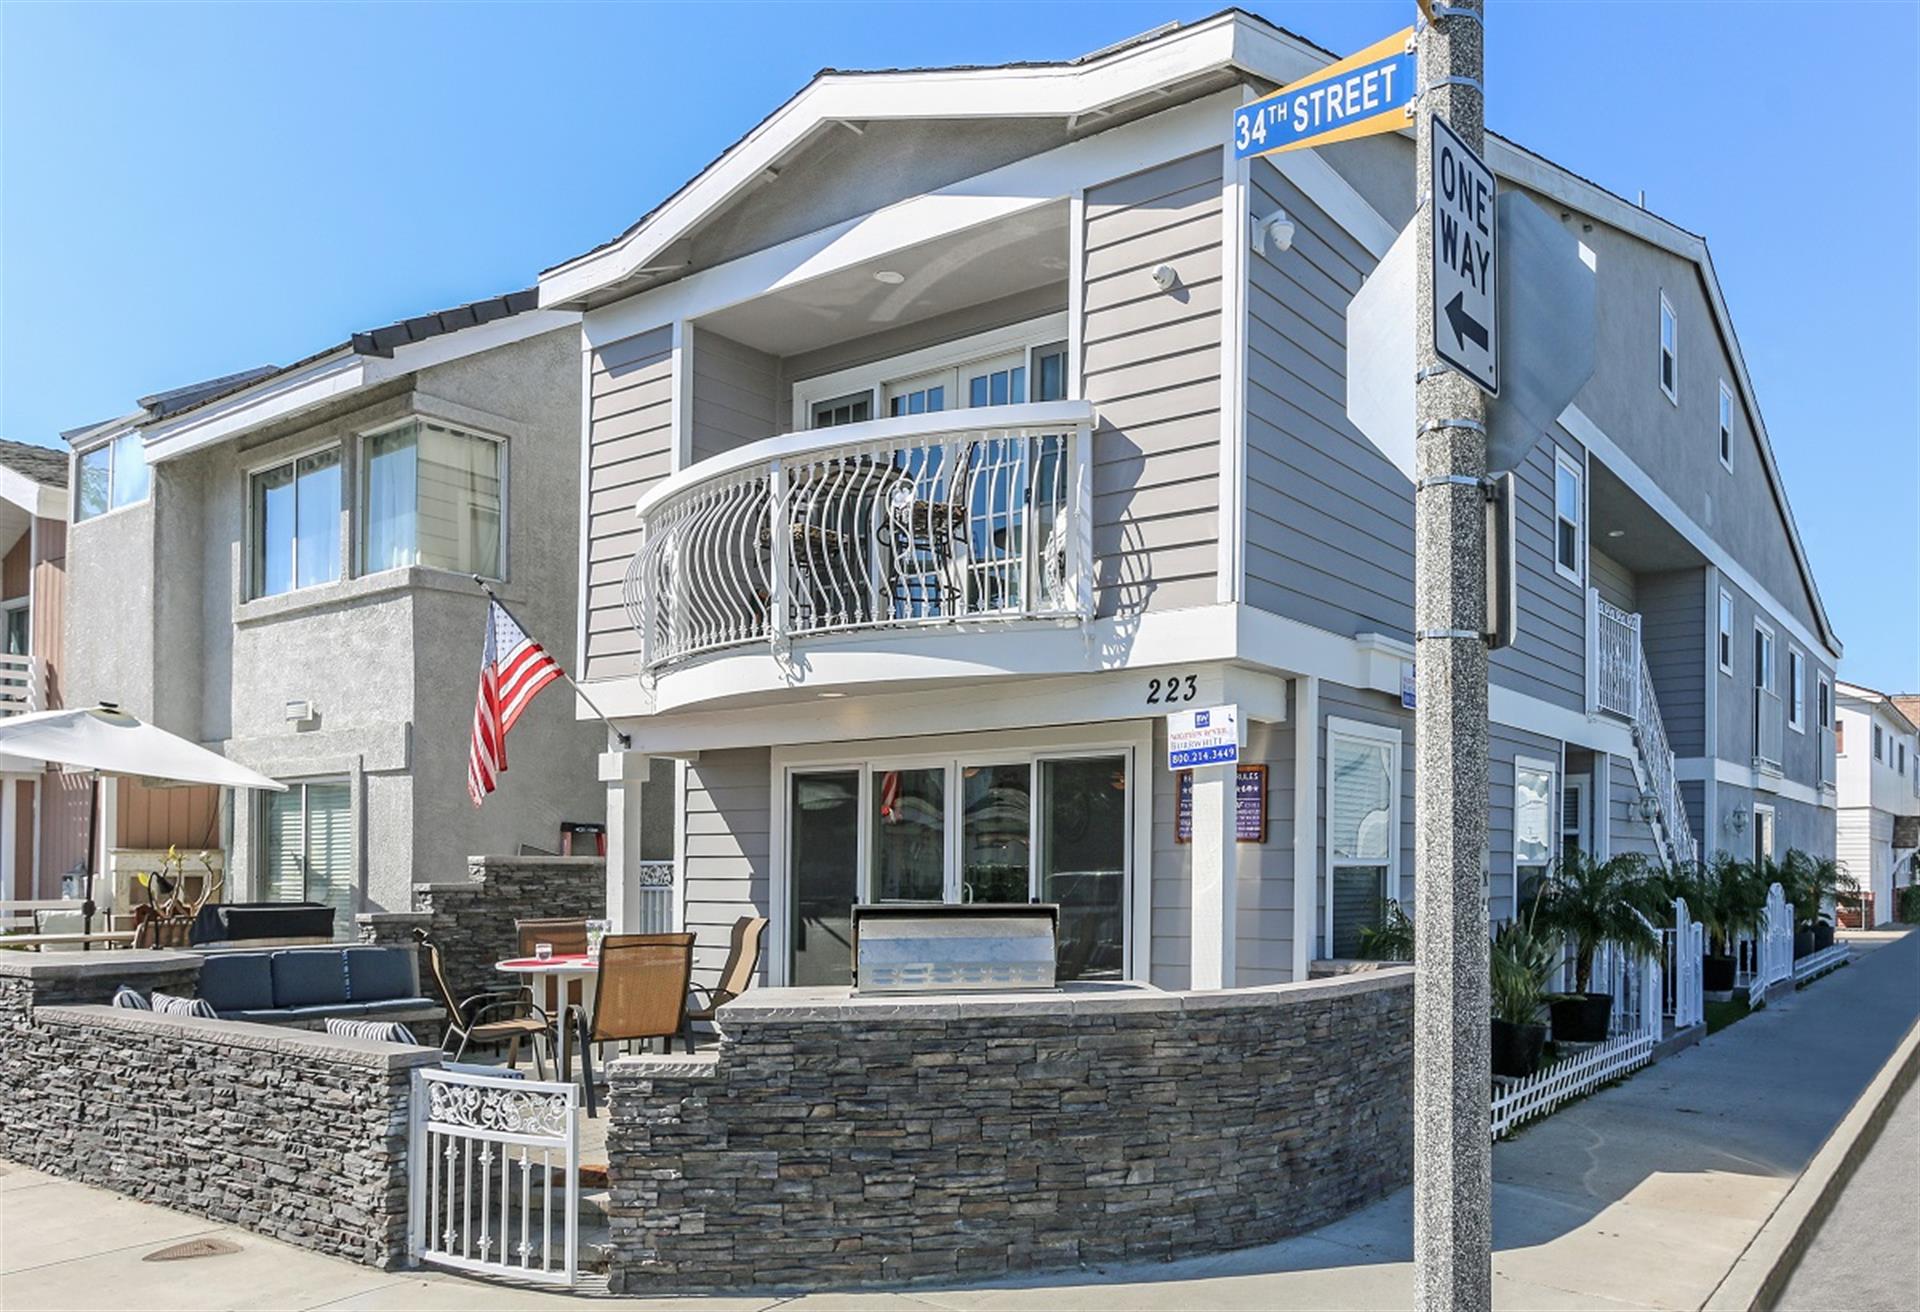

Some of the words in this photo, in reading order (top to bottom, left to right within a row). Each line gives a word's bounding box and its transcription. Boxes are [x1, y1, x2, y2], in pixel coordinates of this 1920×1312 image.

[1293, 63, 1397, 132] STREET
[1440, 146, 1489, 237] ONE
[1440, 207, 1490, 296] WAY
[1146, 674, 1198, 704] 223
